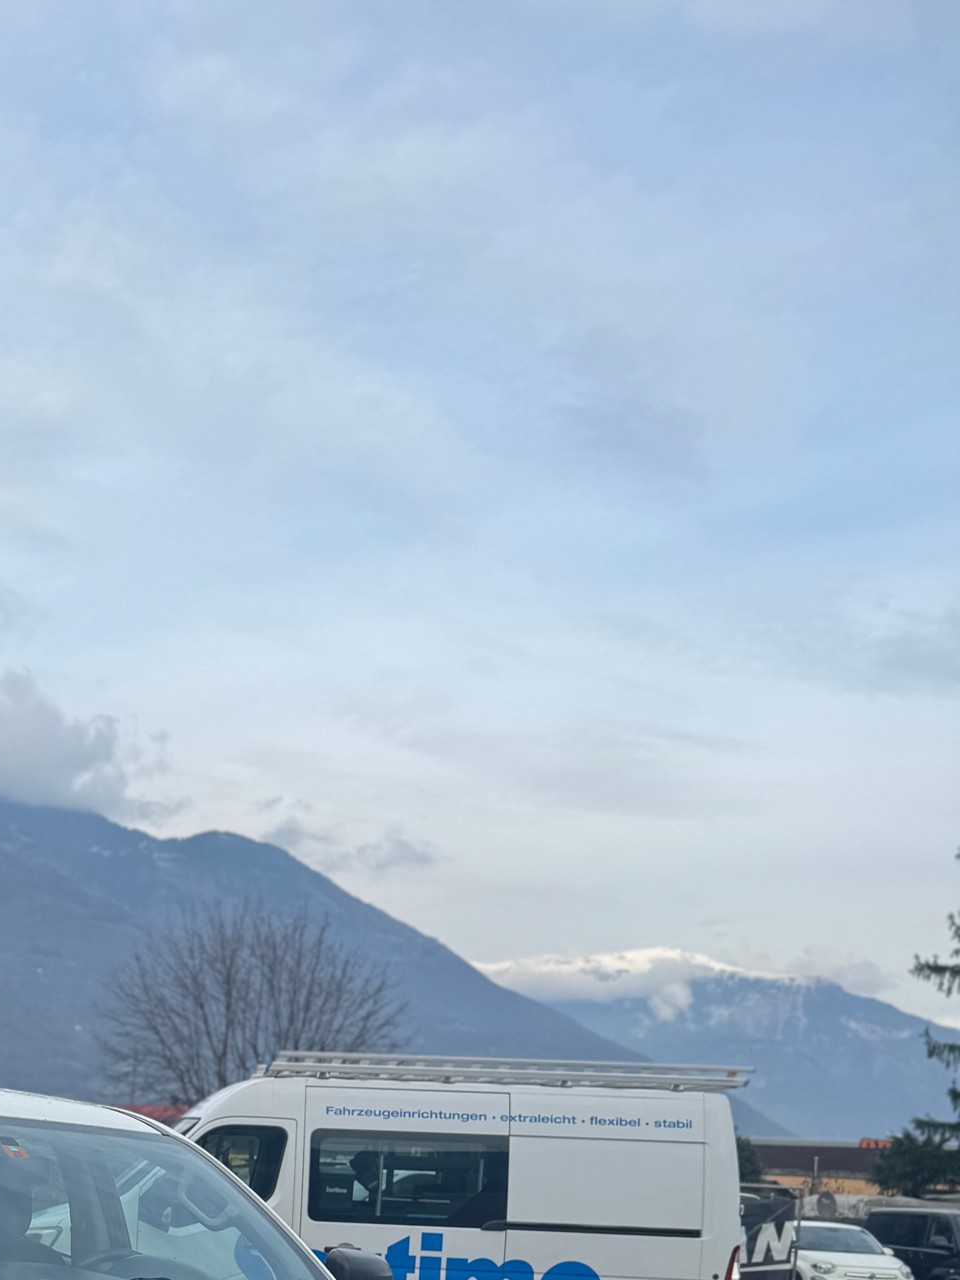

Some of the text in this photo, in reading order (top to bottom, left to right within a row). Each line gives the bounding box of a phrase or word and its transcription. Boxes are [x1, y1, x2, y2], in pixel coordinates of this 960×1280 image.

[325, 1106, 692, 1129] Fahrzeugeinrichtungen extraleicht flexibel stabil
